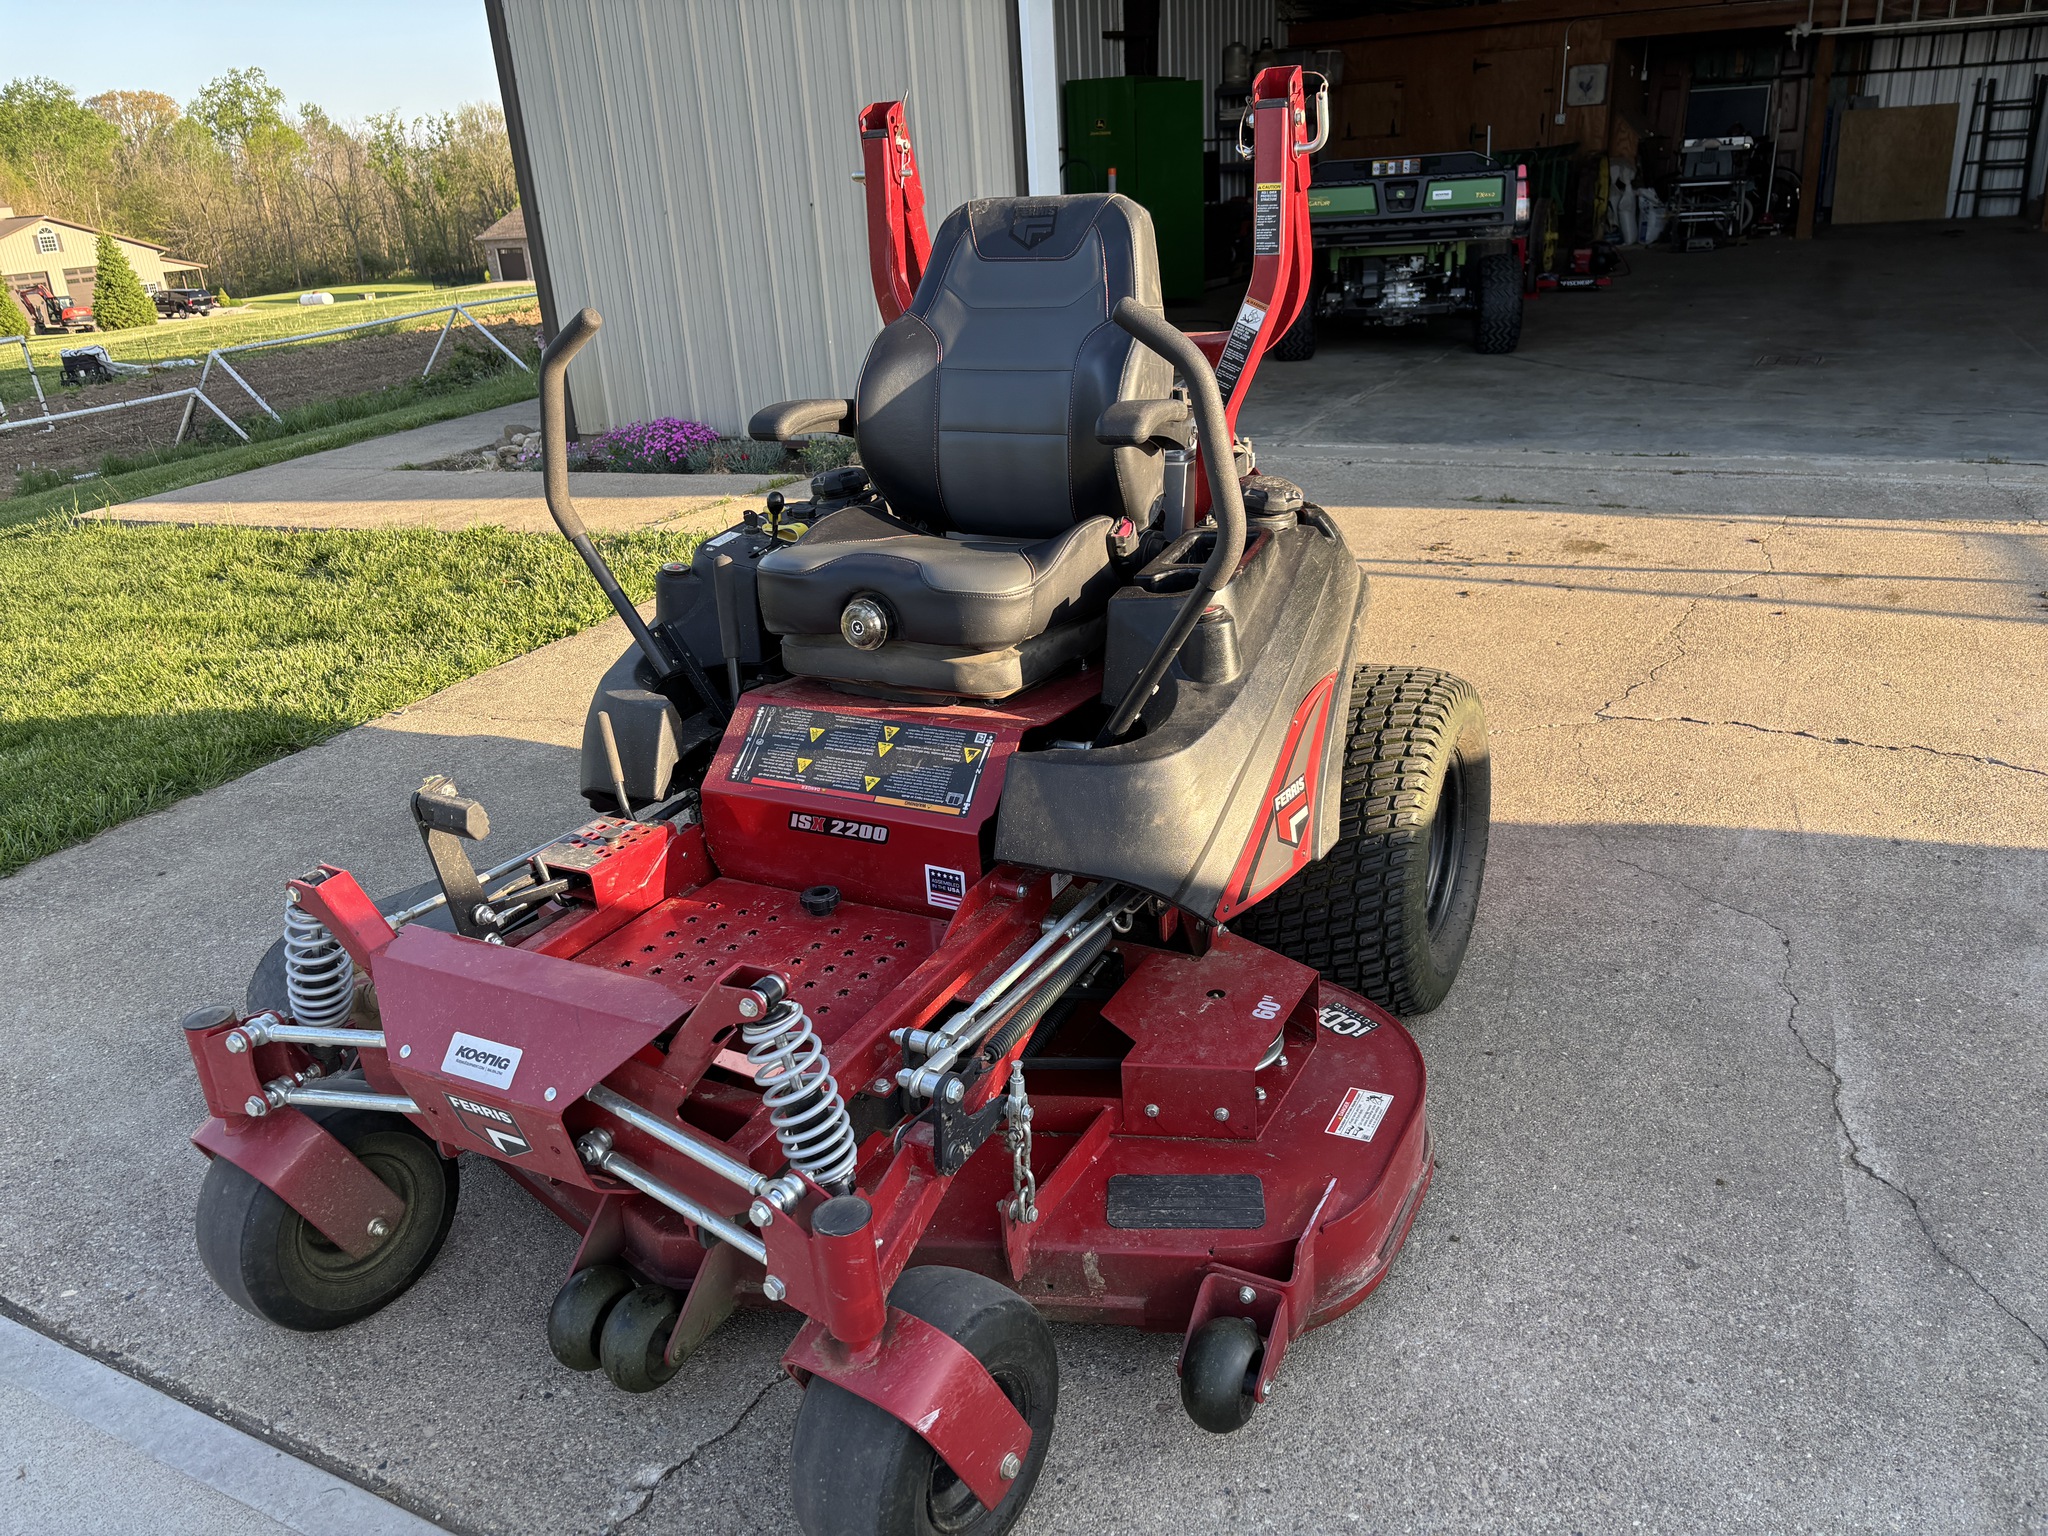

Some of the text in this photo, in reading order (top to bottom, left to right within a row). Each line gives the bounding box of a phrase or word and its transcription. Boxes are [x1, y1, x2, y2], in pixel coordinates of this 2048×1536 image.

[1274, 776, 1305, 811] FERRIS
[790, 813, 888, 842] ISX 2200
[931, 878, 960, 888] ASSEMBLED
[1334, 1002, 1378, 1028] CUTTING
[448, 1096, 512, 1124] FERRIS
[1338, 1101, 1350, 1117] DANGER
